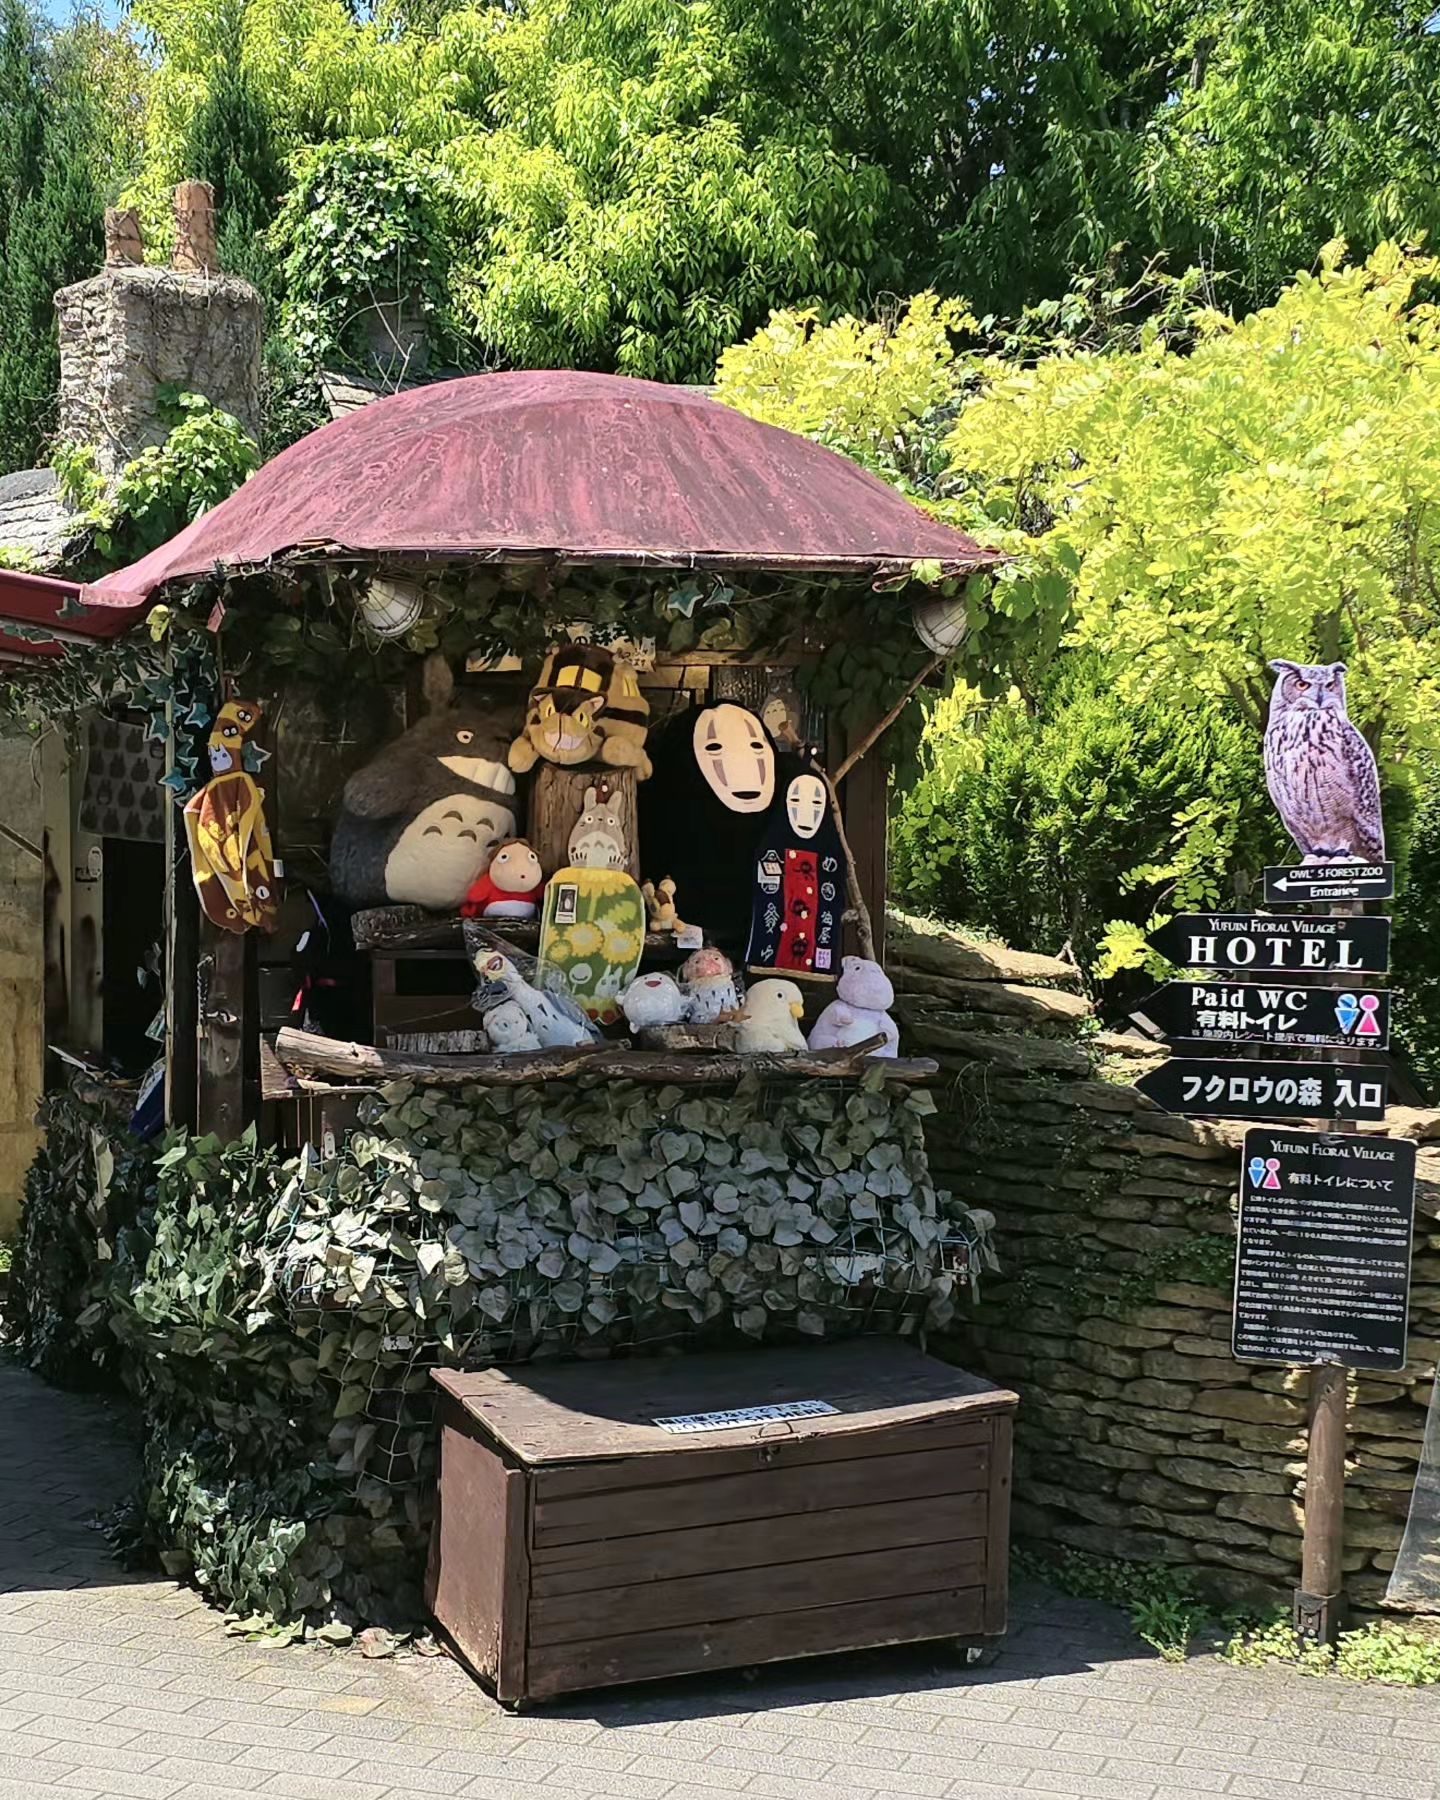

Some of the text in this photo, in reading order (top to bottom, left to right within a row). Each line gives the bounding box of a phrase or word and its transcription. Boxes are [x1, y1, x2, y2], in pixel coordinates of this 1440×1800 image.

[1325, 867, 1360, 877] FOREST
[1360, 866, 1383, 876] ZOO
[1309, 886, 1360, 898] Entrance
[1250, 919, 1290, 933] FLORAL
[1291, 920, 1337, 934] VILLAGE
[1187, 935, 1363, 969] HOTEL
[1191, 987, 1308, 1011] Paid WC
[1196, 1010, 1298, 1031] 有料トイレ
[1182, 1075, 1382, 1108] フクロウの森 入口
[1312, 1143, 1350, 1158] FLORAL
[1352, 1146, 1396, 1161] VILLAGE
[1287, 1172, 1394, 1192] 有料トイレについて
